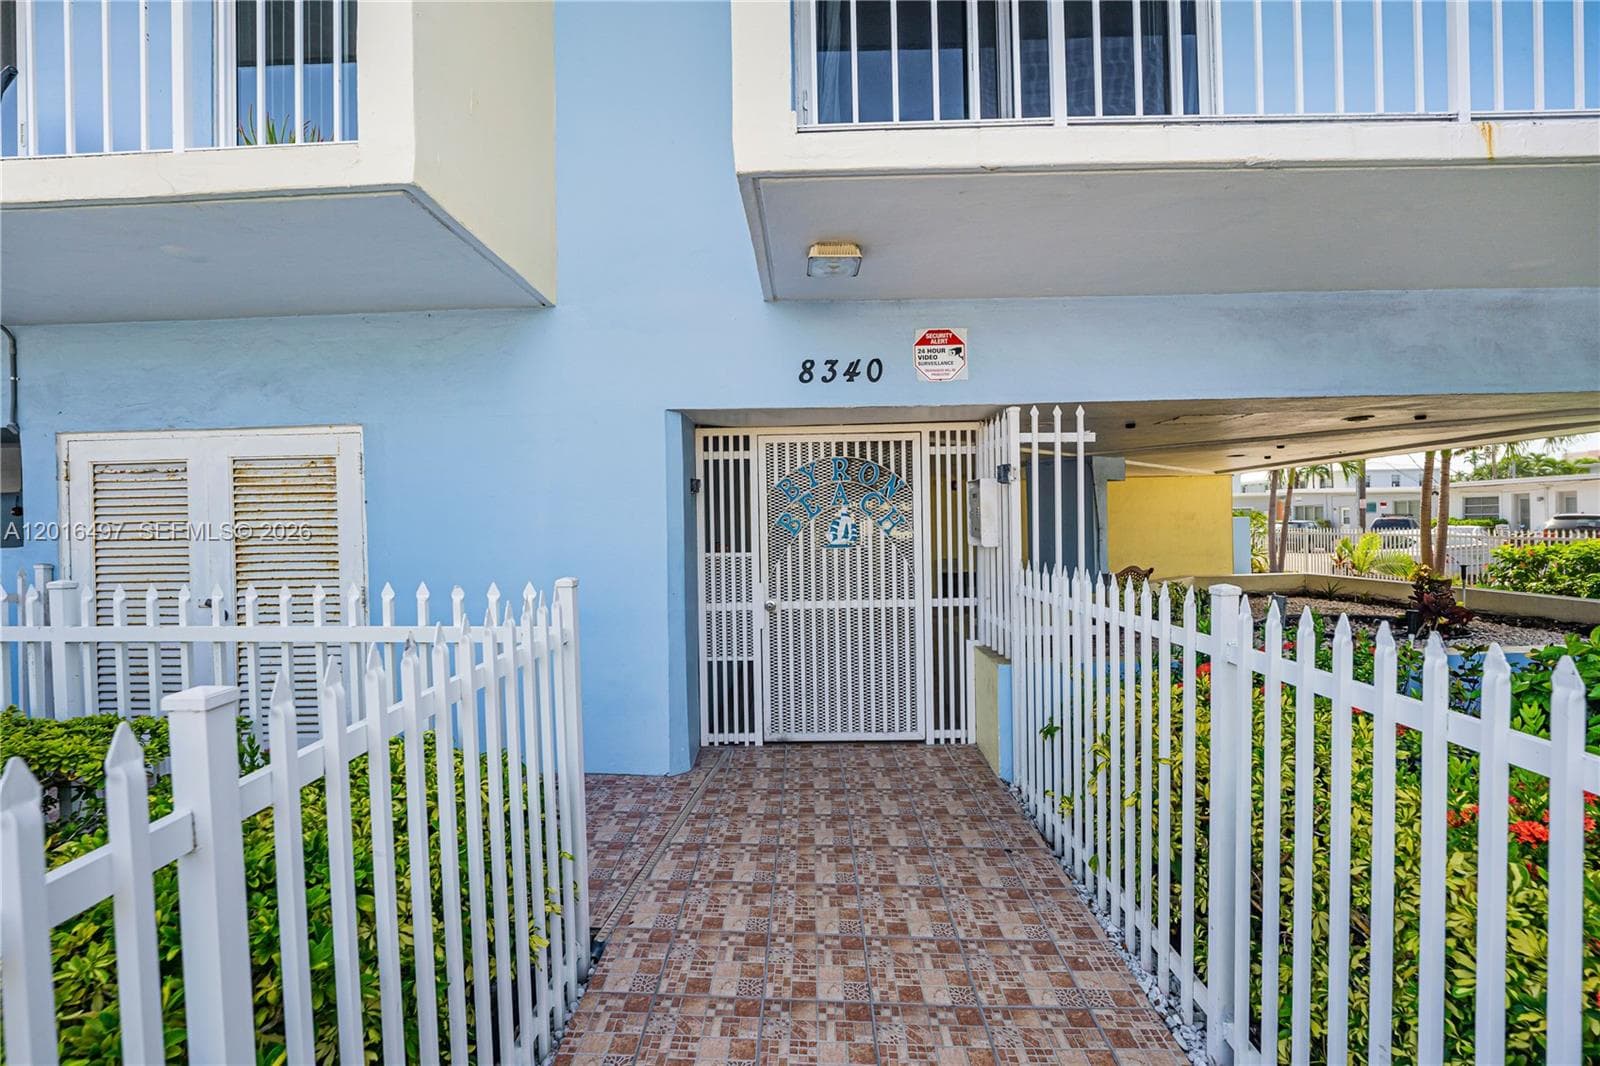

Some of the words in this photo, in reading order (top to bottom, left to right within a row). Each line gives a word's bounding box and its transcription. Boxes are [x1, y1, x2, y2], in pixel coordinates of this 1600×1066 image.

[798, 358, 883, 383] 8340
[775, 456, 905, 503] BYRON
[776, 481, 906, 537] BEACH
